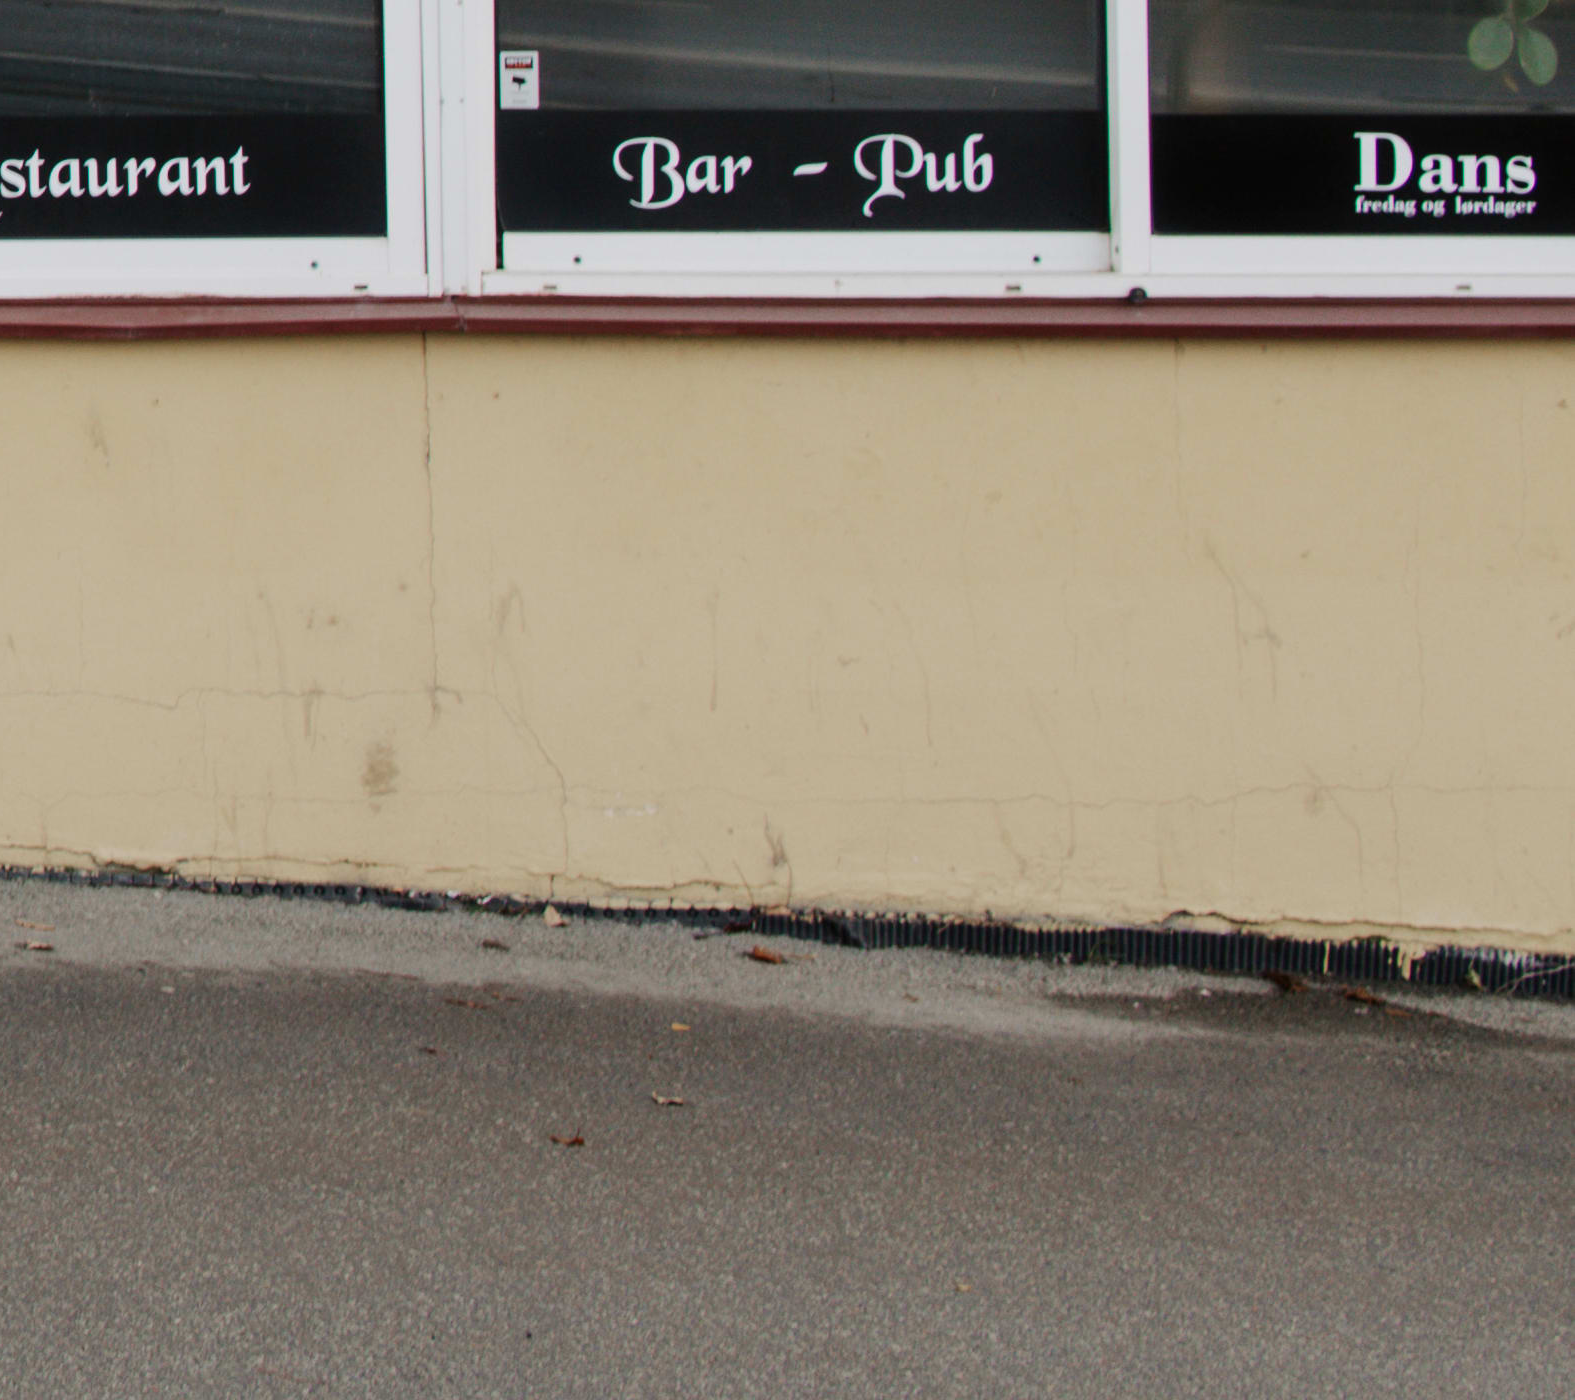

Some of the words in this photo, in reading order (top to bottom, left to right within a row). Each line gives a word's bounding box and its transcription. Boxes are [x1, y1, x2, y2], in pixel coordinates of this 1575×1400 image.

[613, 136, 753, 210] Bar
[793, 161, 828, 176] -
[854, 133, 994, 217] Pub
[1354, 132, 1536, 194] Dans
[1356, 195, 1417, 217] fredag
[1421, 199, 1445, 218] og
[1455, 195, 1536, 218] lørdager
